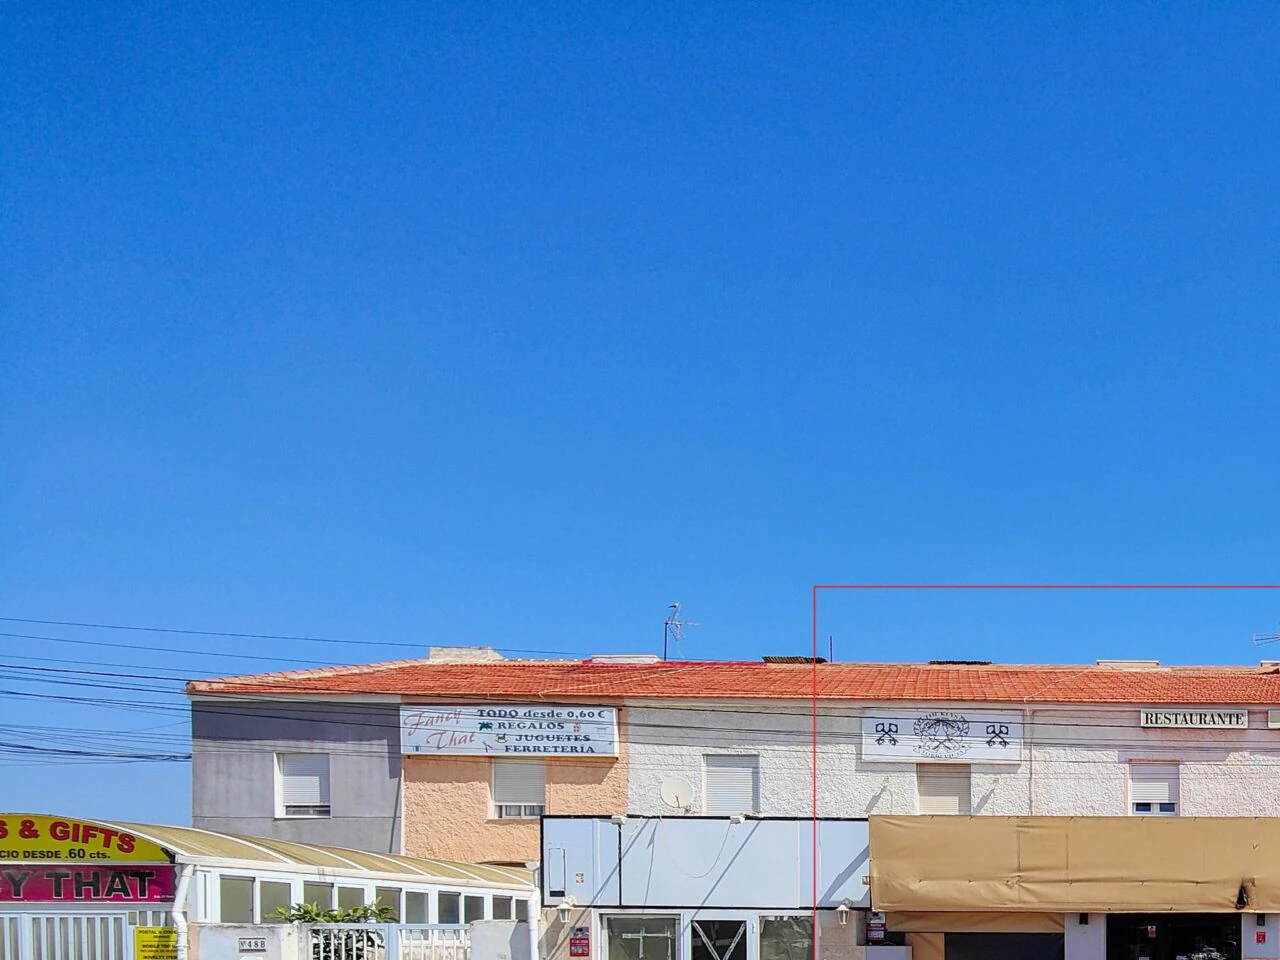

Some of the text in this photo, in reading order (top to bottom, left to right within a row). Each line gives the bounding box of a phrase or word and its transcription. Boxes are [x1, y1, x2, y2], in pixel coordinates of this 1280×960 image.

[477, 709, 518, 718] TODO
[523, 709, 562, 718] desde
[1144, 712, 1244, 726] RESTAURANTE
[403, 707, 461, 736] Fancy
[497, 721, 565, 730] REGALOS
[426, 731, 476, 750] That
[515, 734, 592, 742] JUGUETES
[505, 743, 595, 753] FERRETERÍA
[19, 819, 41, 839] &
[50, 821, 136, 854] GIFTS
[23, 850, 61, 858] DESDE
[90, 850, 111, 859] cts.
[45, 870, 156, 899] THAT
